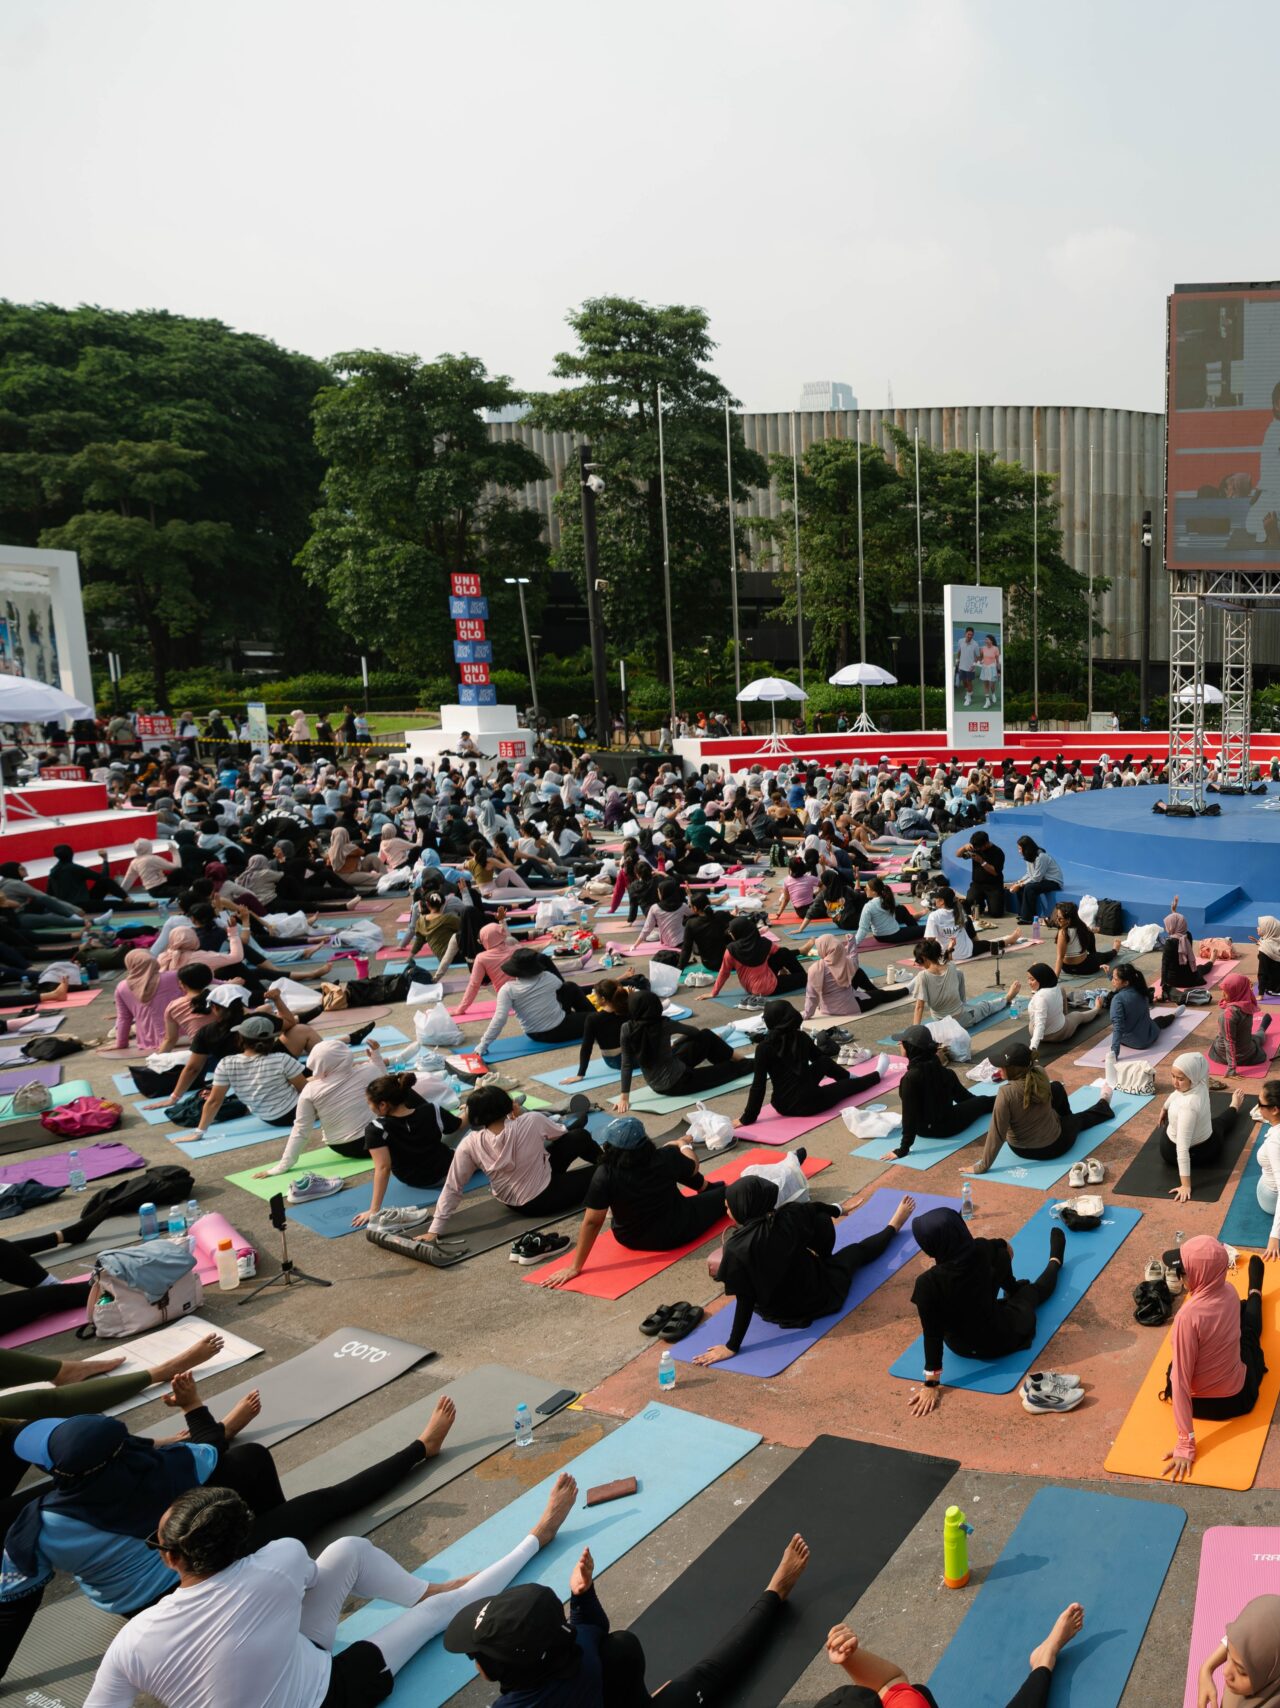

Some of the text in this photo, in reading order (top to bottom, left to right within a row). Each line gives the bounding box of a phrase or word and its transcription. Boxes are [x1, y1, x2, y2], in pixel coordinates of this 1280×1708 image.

[454, 575, 475, 585] UNI
[455, 585, 477, 595] QLO
[459, 620, 479, 630] UNI
[460, 630, 482, 640] QLO
[464, 664, 484, 674] UNI
[465, 673, 487, 684] QLO
[60, 770, 82, 780] UNI
[256, 809, 309, 829] URBAN
